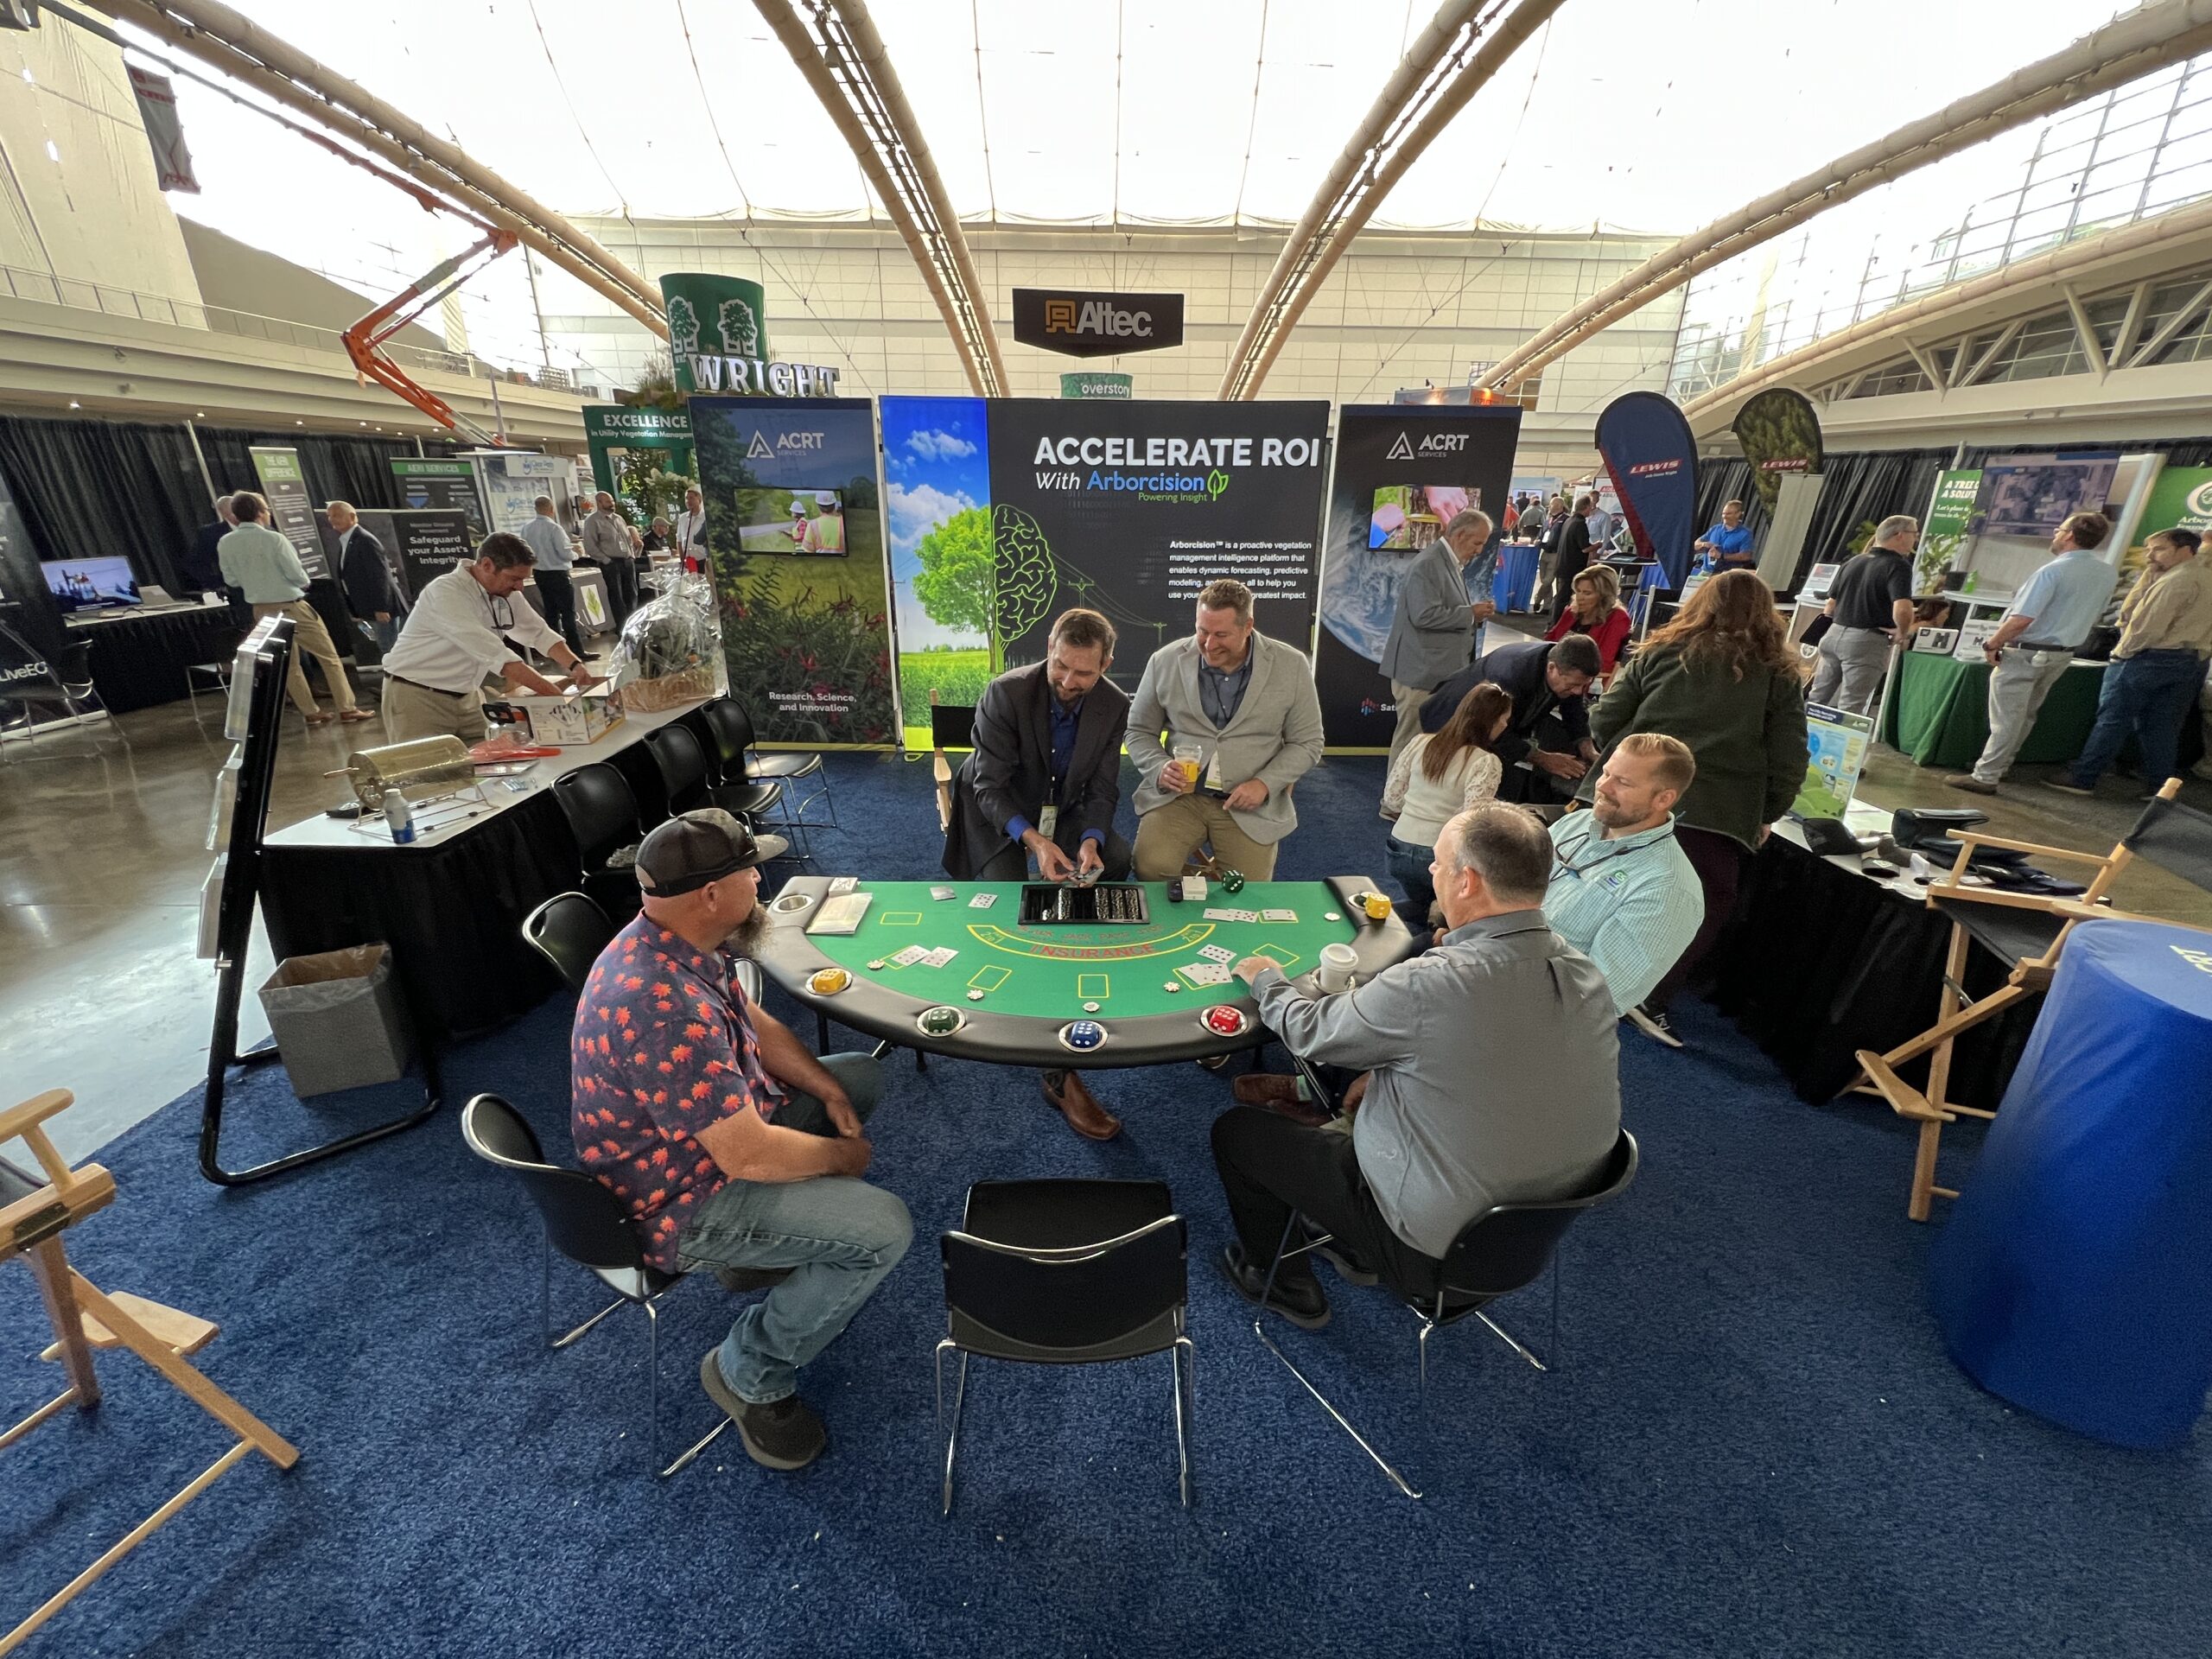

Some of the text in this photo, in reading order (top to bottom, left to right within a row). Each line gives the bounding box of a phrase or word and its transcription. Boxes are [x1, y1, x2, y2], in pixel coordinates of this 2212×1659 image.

[1077, 301, 1153, 337] Altec
[686, 354, 840, 397] WRIGHT
[1082, 383, 1130, 397] overstory
[603, 415, 688, 428] EXCELLENCE
[600, 429, 619, 438] Utility
[777, 433, 824, 448] ACRT
[1419, 434, 1469, 450] ACRT
[1034, 436, 1319, 467] ACCELERATE ROI
[1630, 461, 1679, 474] LEWIS
[1762, 460, 1808, 469] LEWIS
[1036, 470, 1205, 491] With Arborcision
[1138, 492, 1207, 504] Powering Insight
[410, 536, 461, 544] Safeguard
[1239, 542, 1273, 550] proactive
[1274, 542, 1312, 550] vegetation
[408, 547, 430, 556] your
[1169, 554, 1217, 563] management
[1218, 554, 1258, 563] intelligence
[1260, 554, 1289, 563] platform
[1199, 567, 1230, 575] dynamic
[1230, 567, 1272, 575] forecasting,
[1168, 579, 1203, 588] modeling,
[1266, 579, 1281, 588] help
[769, 692, 857, 702] Research, Science,
[1030, 943, 1155, 959] INSURANCE
